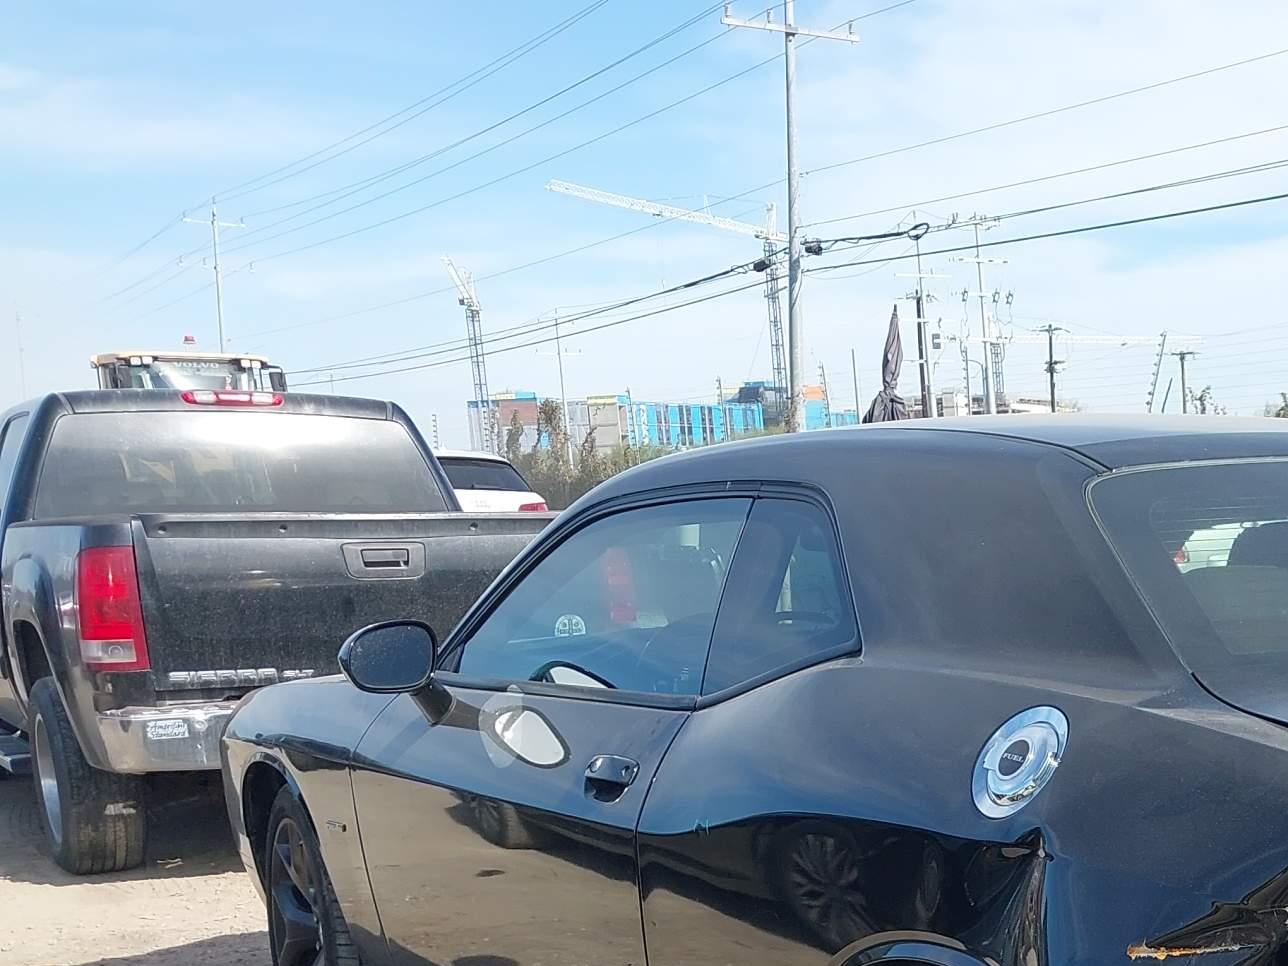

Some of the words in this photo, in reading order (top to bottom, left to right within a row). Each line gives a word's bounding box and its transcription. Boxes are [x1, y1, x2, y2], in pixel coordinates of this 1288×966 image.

[175, 361, 220, 369] VOLVO
[168, 668, 279, 683] SIERRA
[1002, 752, 1024, 763] FUEL
